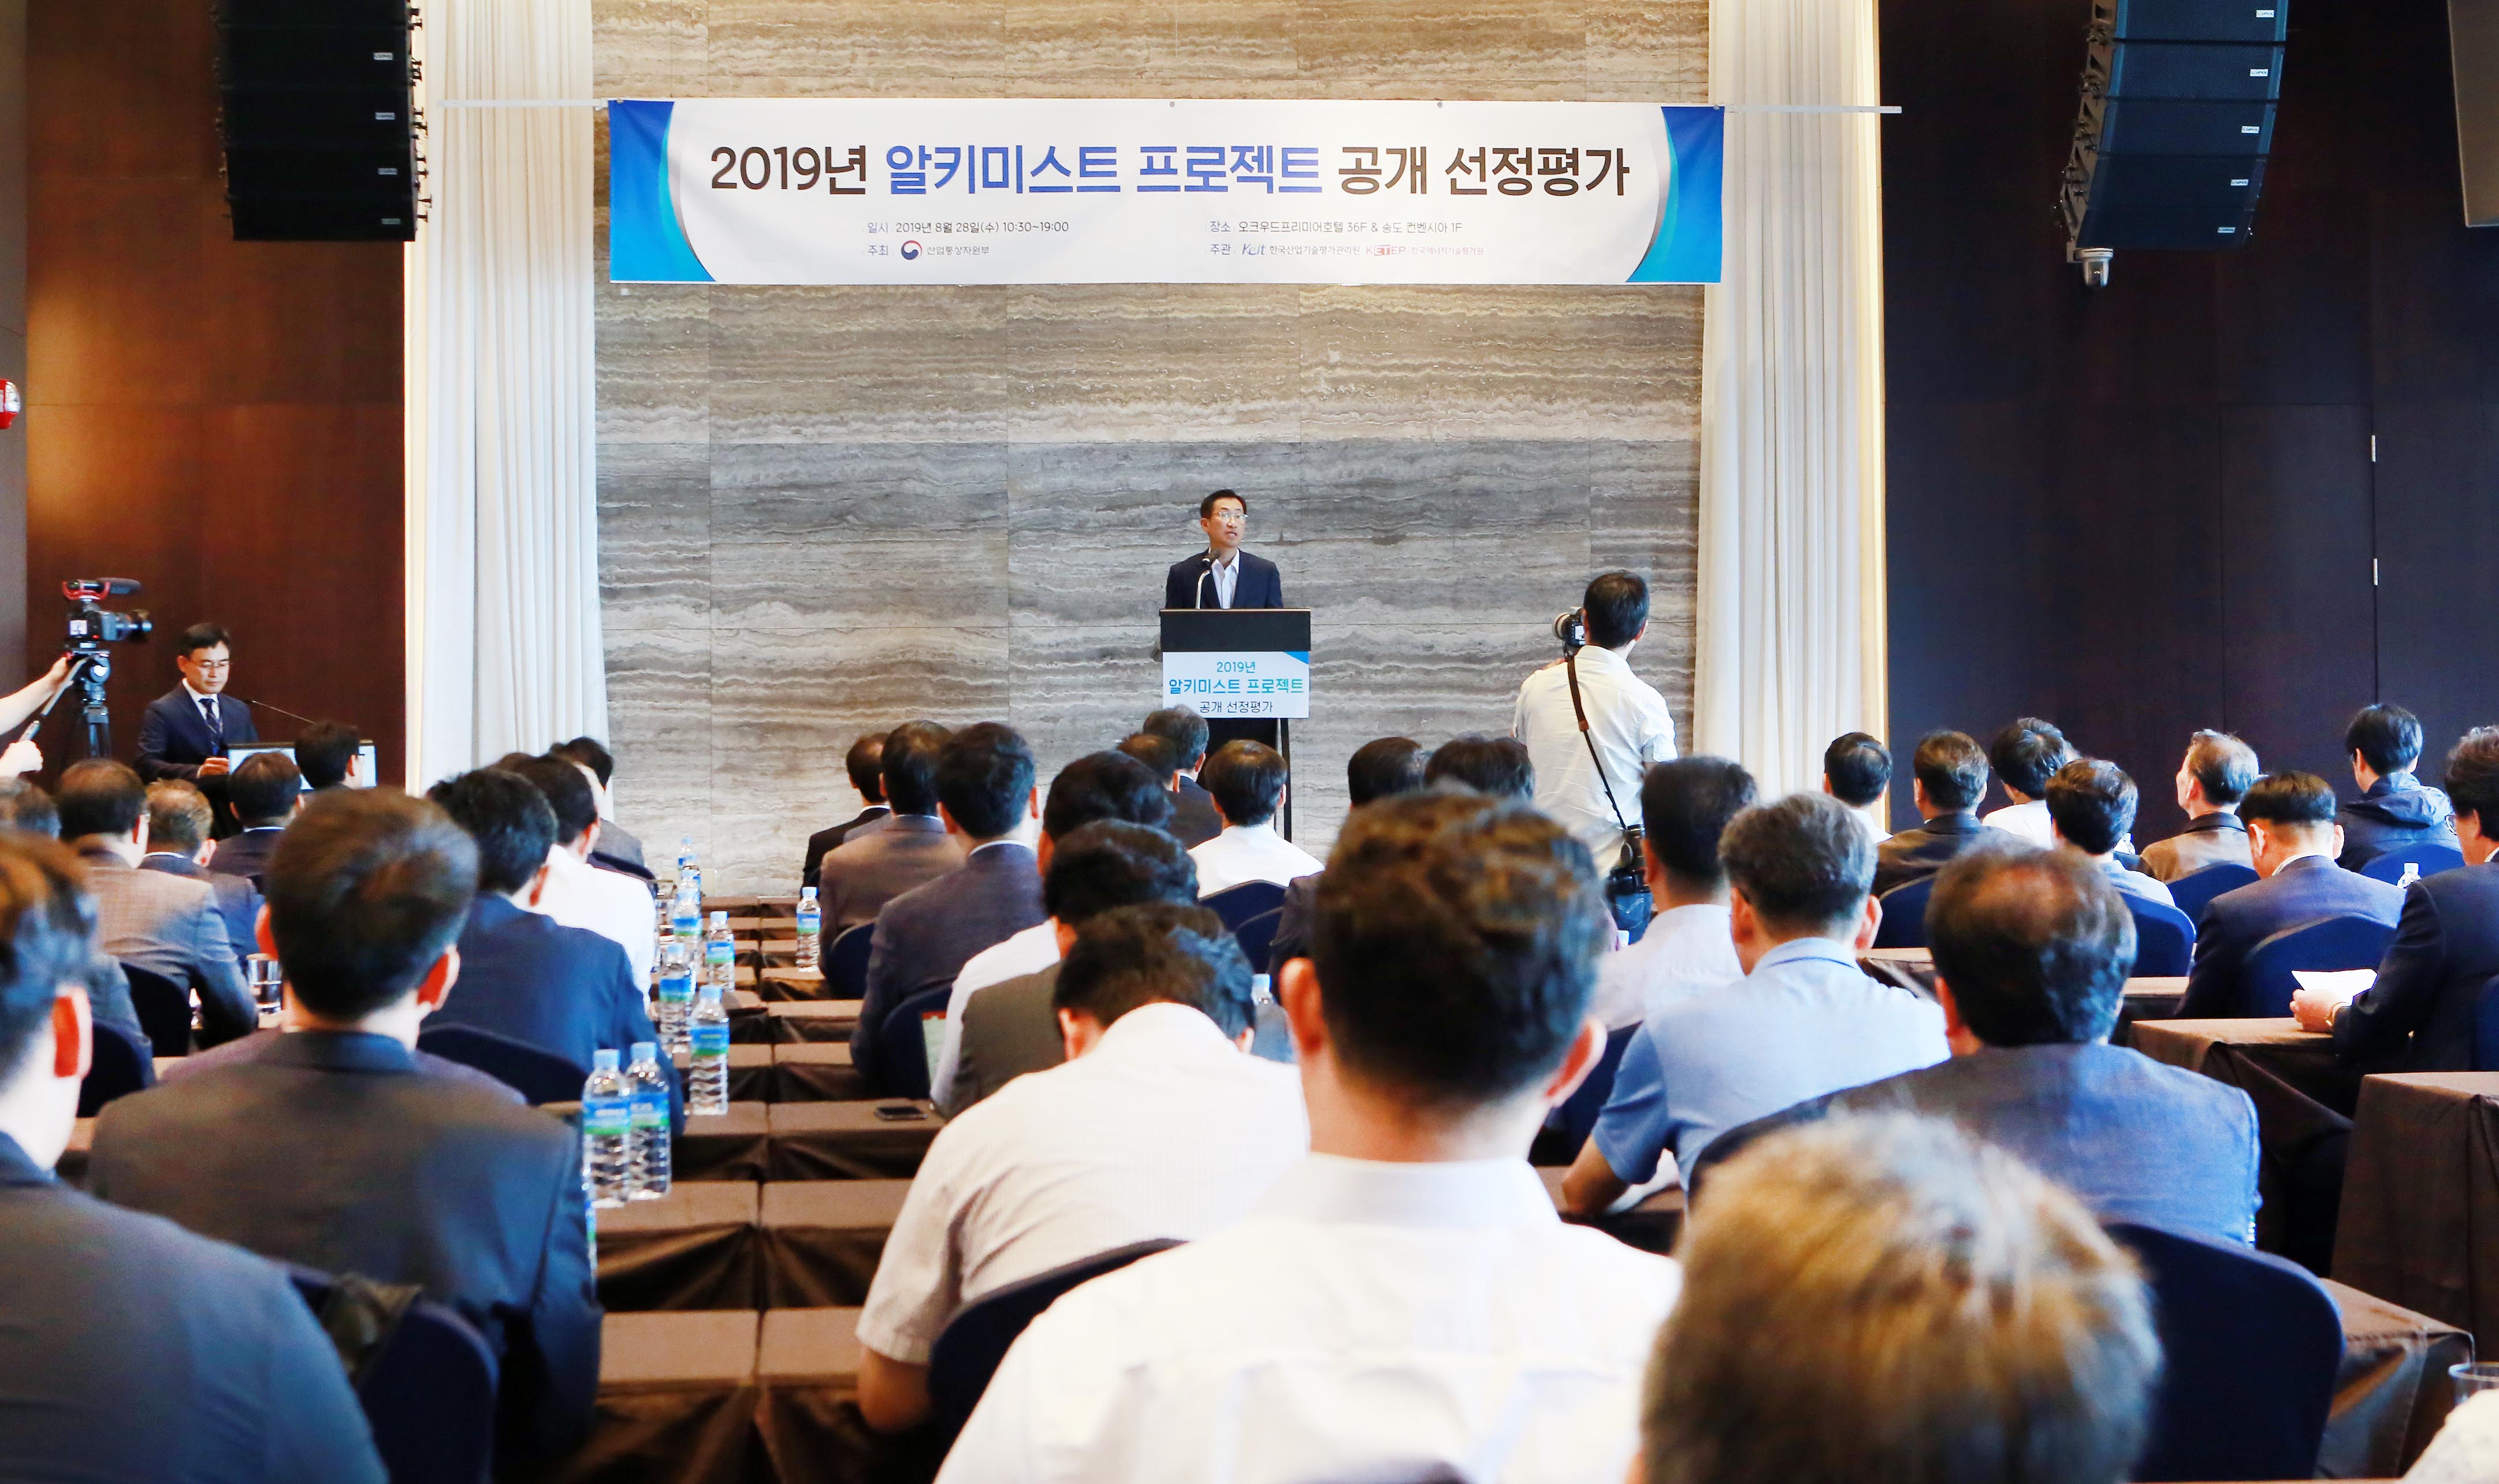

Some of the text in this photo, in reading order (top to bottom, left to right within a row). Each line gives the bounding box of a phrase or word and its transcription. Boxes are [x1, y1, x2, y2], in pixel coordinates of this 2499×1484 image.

[711, 144, 1631, 198] 2019년 알키미스트 프로젝트 공개 선정평가
[867, 221, 1070, 234] 일시 2019년 8월 28일(수) 10:30~19:00
[1210, 221, 1463, 233] 장소 오크우드프리미어호텔 36F & 송도 컨벤시아 1F
[867, 244, 990, 256] 주최 산업통상자원부
[1210, 244, 1232, 256] 주관
[1269, 245, 1360, 256] 한국산업기술평가관리원
[1216, 661, 1256, 674] 2019년
[1169, 678, 1304, 694] 알키미스트 프로젝트
[1199, 700, 1274, 714] 공개 선정평가
